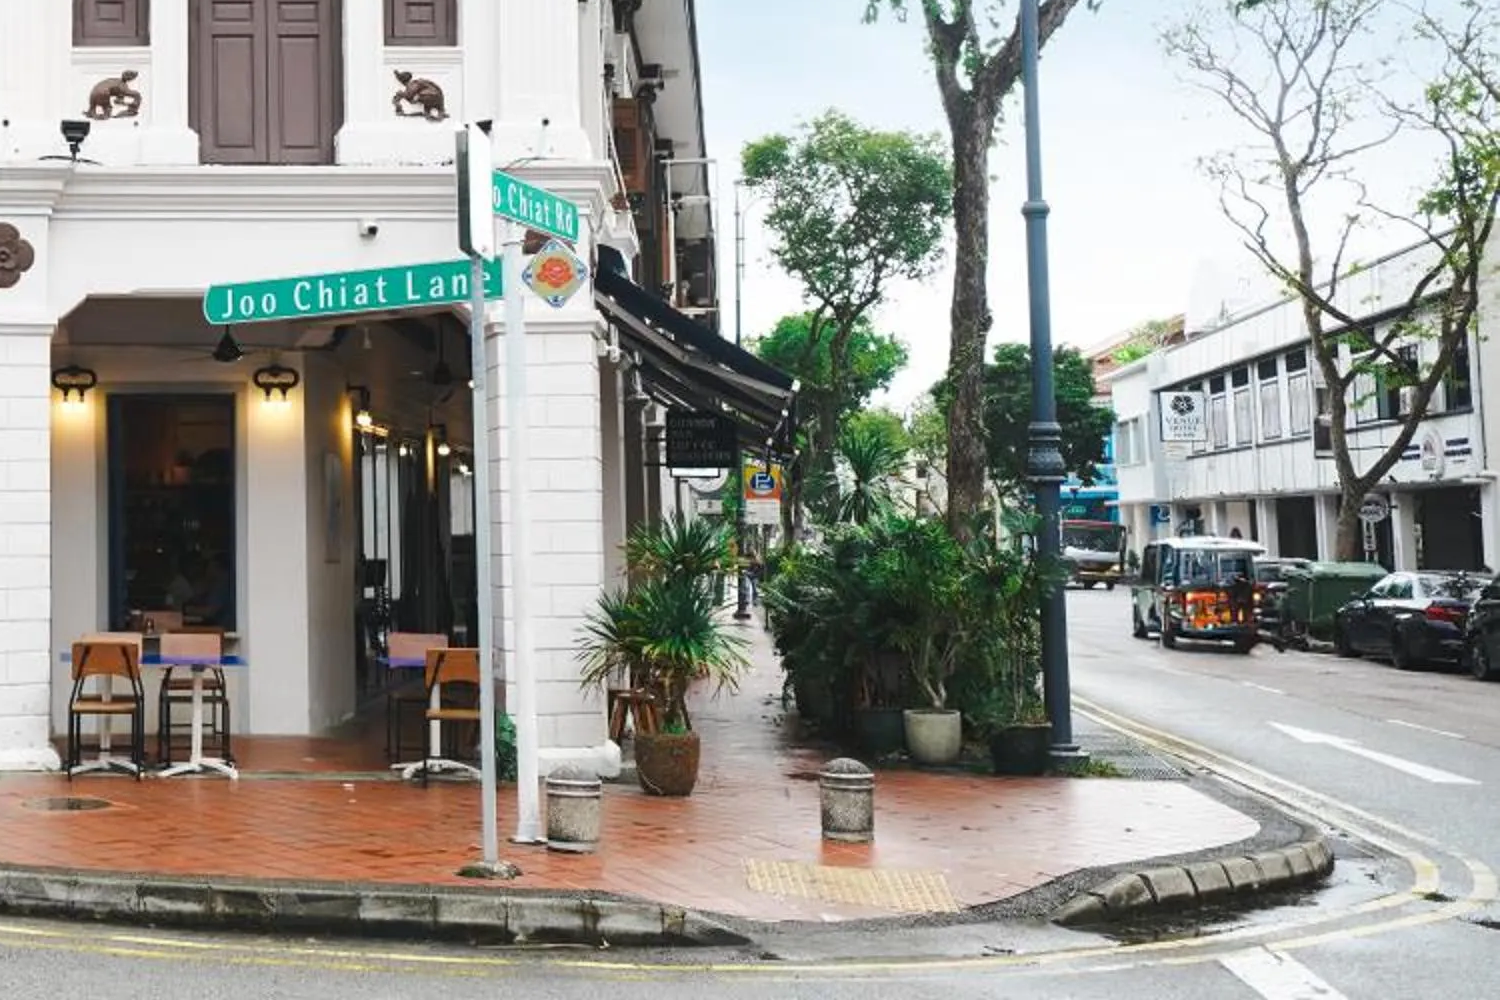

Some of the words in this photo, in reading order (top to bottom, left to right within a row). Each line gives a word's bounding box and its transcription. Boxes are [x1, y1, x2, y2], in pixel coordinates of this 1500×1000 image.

[507, 182, 551, 227] Chiat
[555, 200, 573, 236] Rd
[221, 288, 276, 319] Joo
[293, 275, 388, 311] Chiat
